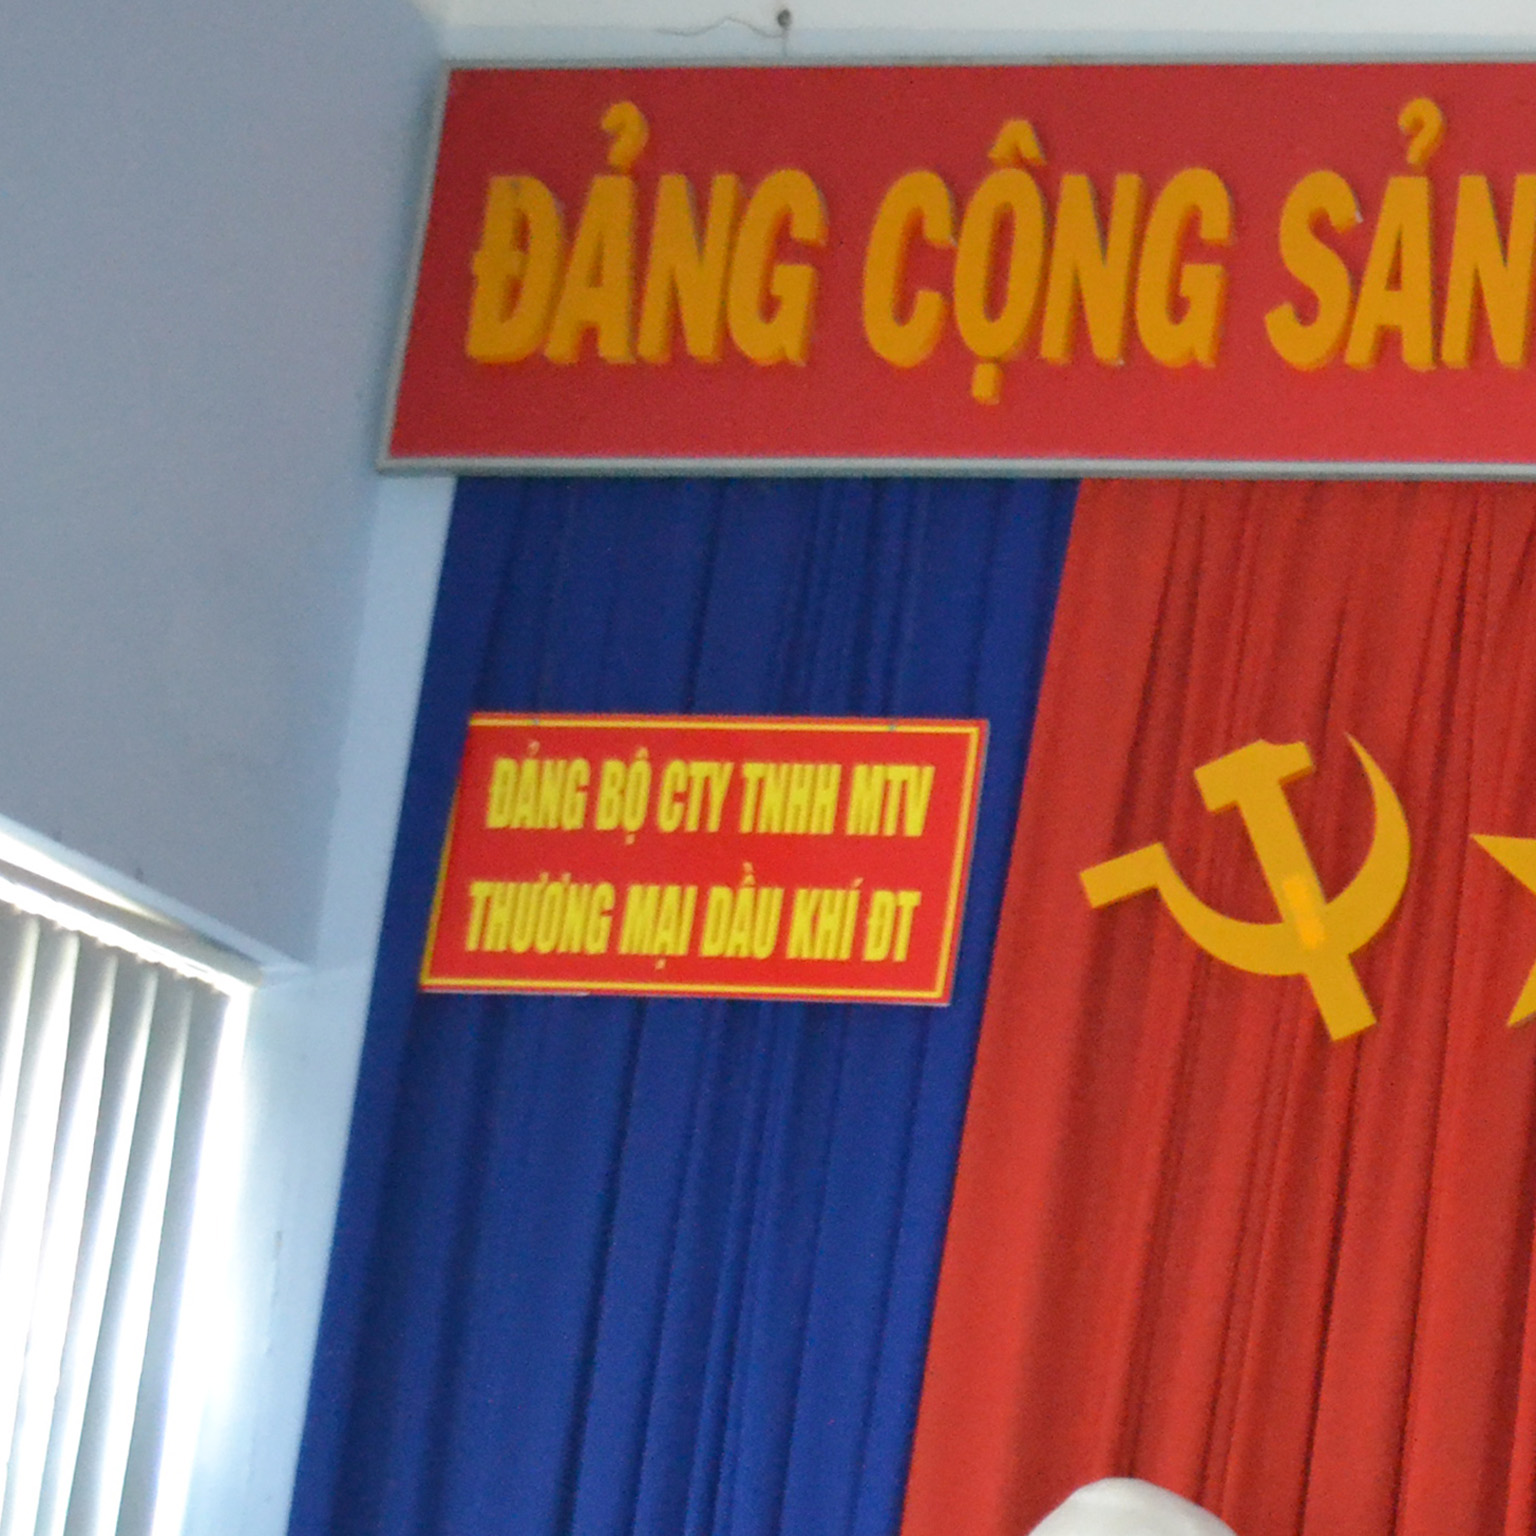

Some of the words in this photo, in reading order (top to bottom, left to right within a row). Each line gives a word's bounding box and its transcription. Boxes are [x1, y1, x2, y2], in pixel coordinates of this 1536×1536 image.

[464, 100, 828, 368] ĐẢNG
[861, 118, 1234, 405] CỘNG
[485, 738, 592, 831] ĐẢNG
[594, 746, 654, 845] BỘ
[655, 759, 735, 834] CTY
[738, 760, 843, 837] TNHH
[844, 763, 937, 838] MTV
[465, 871, 616, 956] THƯƠNG
[617, 883, 699, 970] MẠI
[699, 861, 786, 961] DẦU
[785, 878, 864, 962] KHÍ
[862, 888, 922, 963] ĐT
